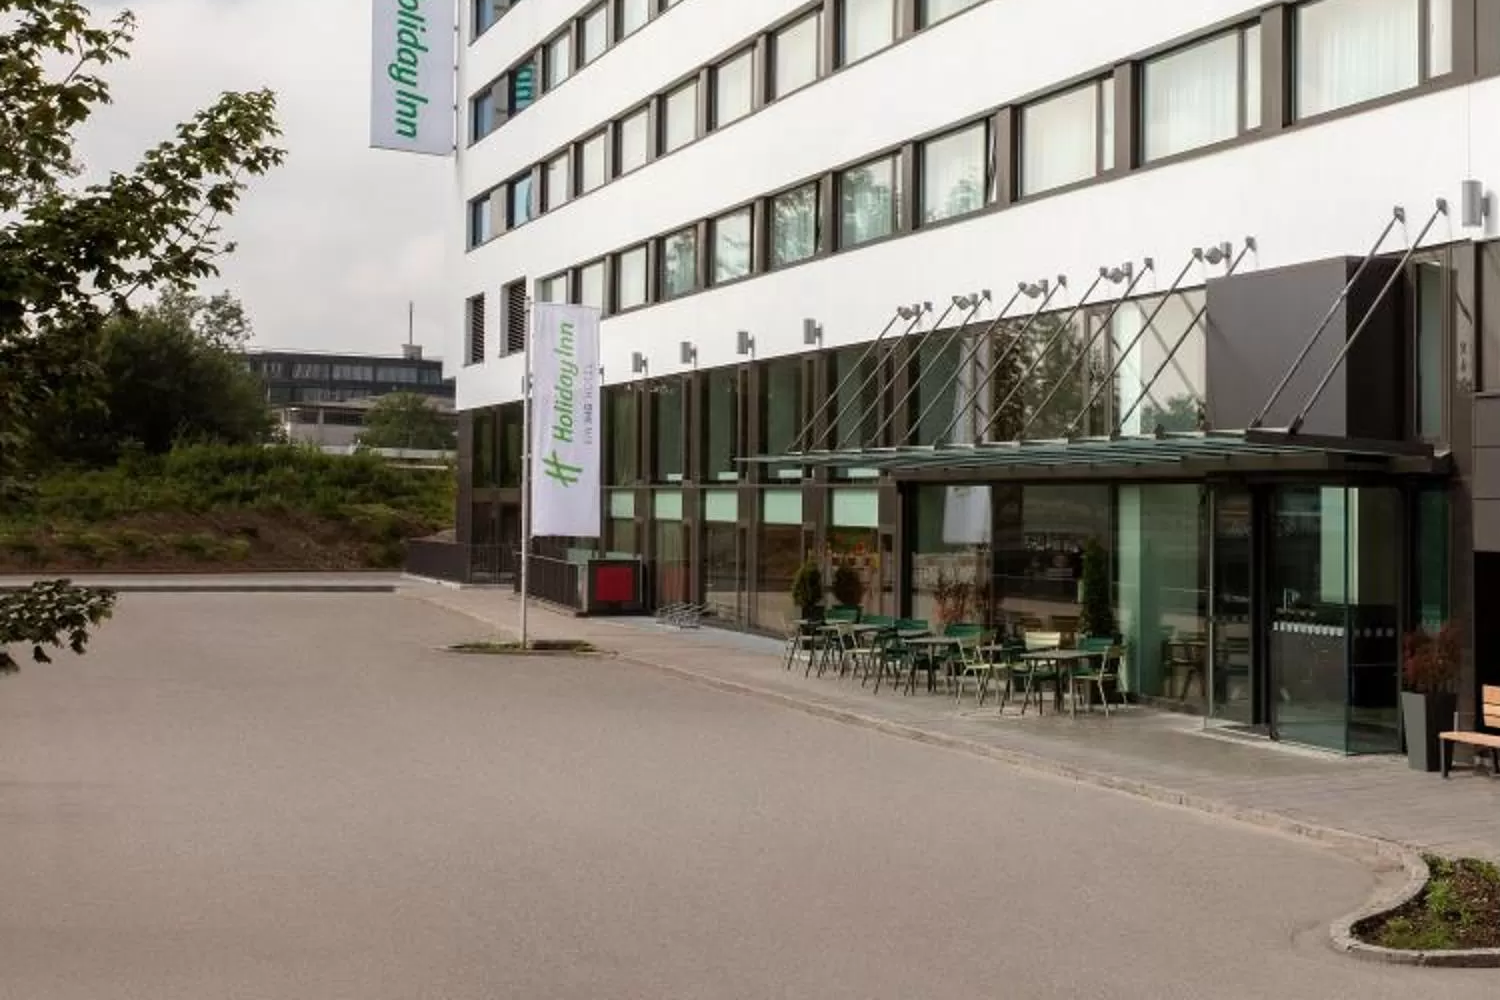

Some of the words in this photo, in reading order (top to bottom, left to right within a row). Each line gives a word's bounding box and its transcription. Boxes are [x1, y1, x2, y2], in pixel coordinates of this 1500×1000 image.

[396, 89, 428, 139] Inn
[553, 322, 574, 358] Inn
[553, 360, 578, 443] Holiday
